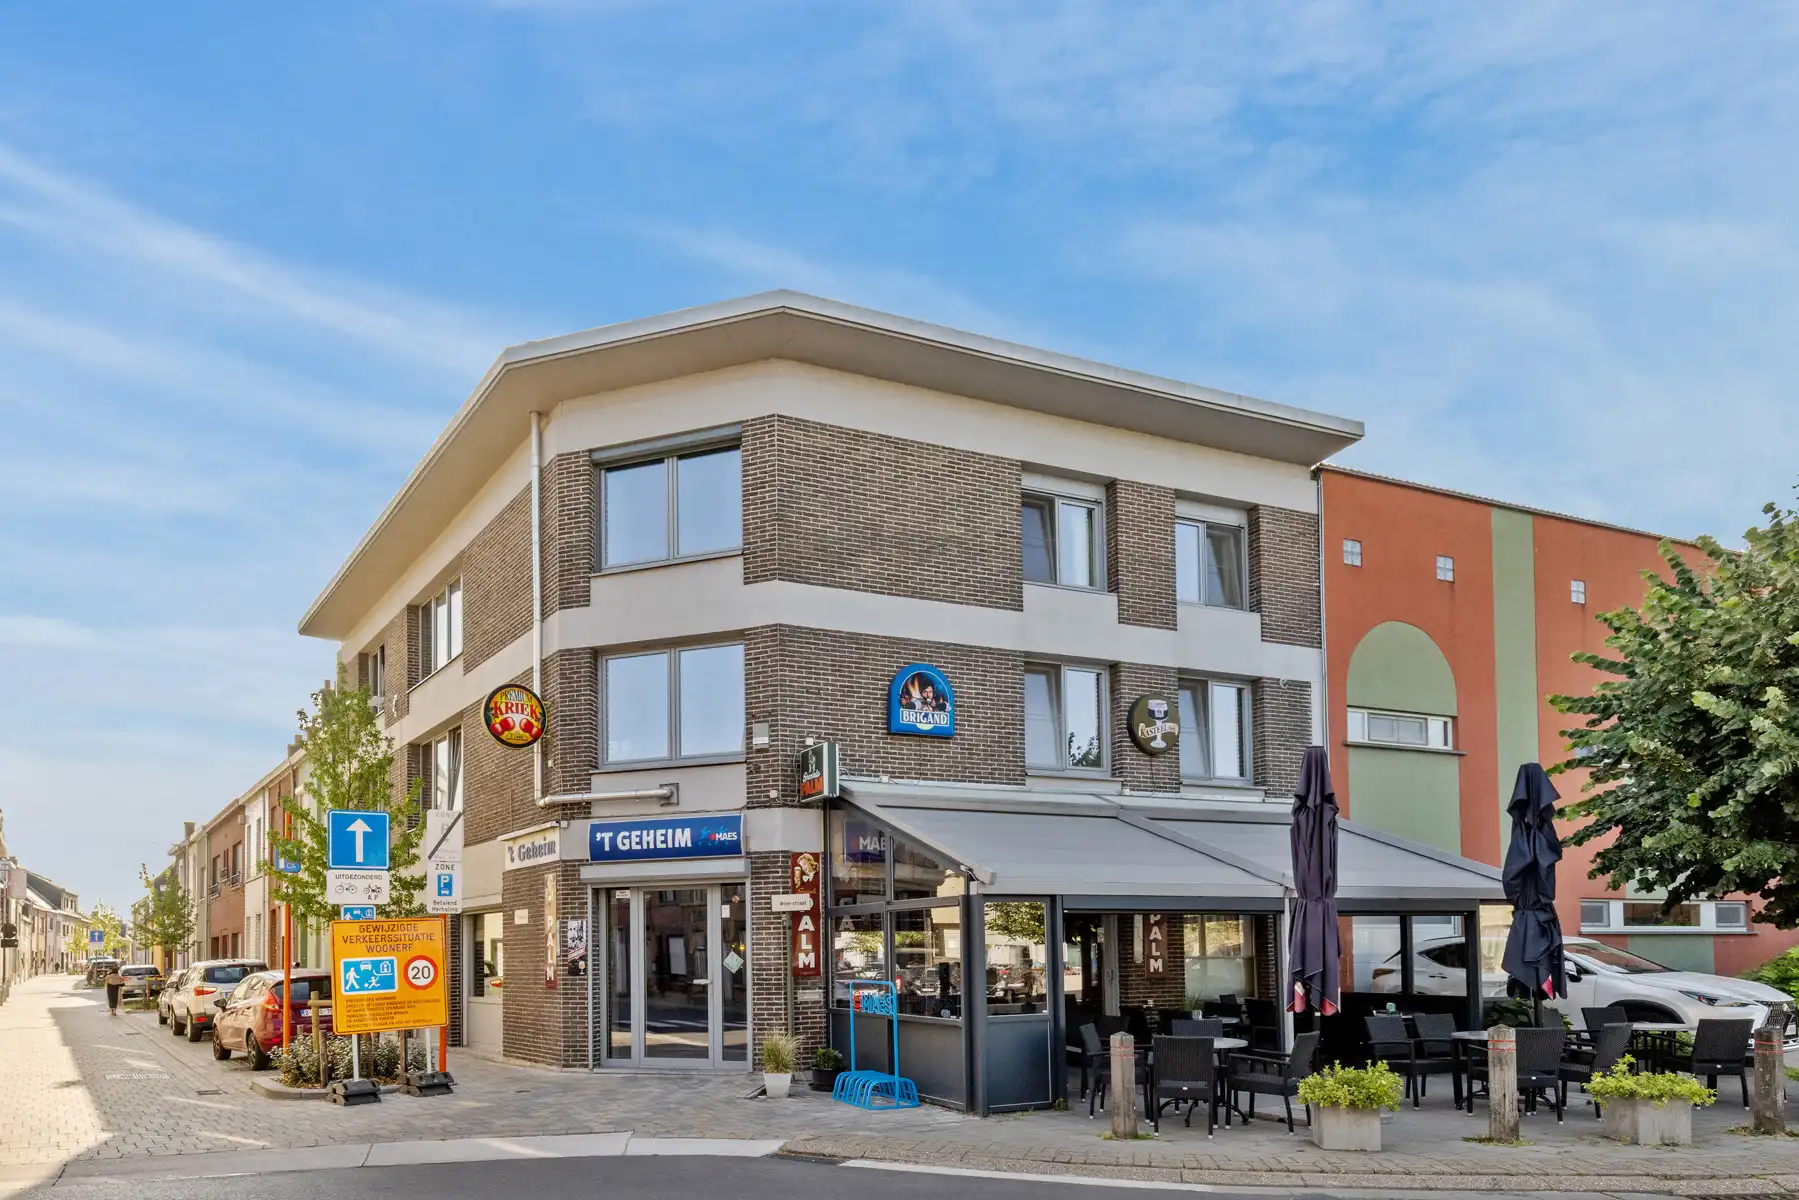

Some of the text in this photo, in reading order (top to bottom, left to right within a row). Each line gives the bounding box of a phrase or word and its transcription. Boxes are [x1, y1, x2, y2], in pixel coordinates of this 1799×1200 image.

[500, 688, 533, 703] PREMIUM
[493, 701, 539, 722] KRIEK
[902, 710, 948, 725] BRIGAND
[595, 827, 692, 851] 'T GEHEIM
[715, 831, 738, 841] MAES
[859, 835, 886, 851] MAE
[517, 836, 556, 862] Geheim
[435, 863, 456, 871] ZONE
[335, 873, 383, 881] UITGEZONDERD
[358, 923, 419, 934] GEWIJZIGDE
[342, 932, 435, 944] VERKEERSSITUATIE
[366, 943, 413, 954] WOONERF
[411, 965, 431, 980] 20
[861, 992, 893, 1016] MAES
